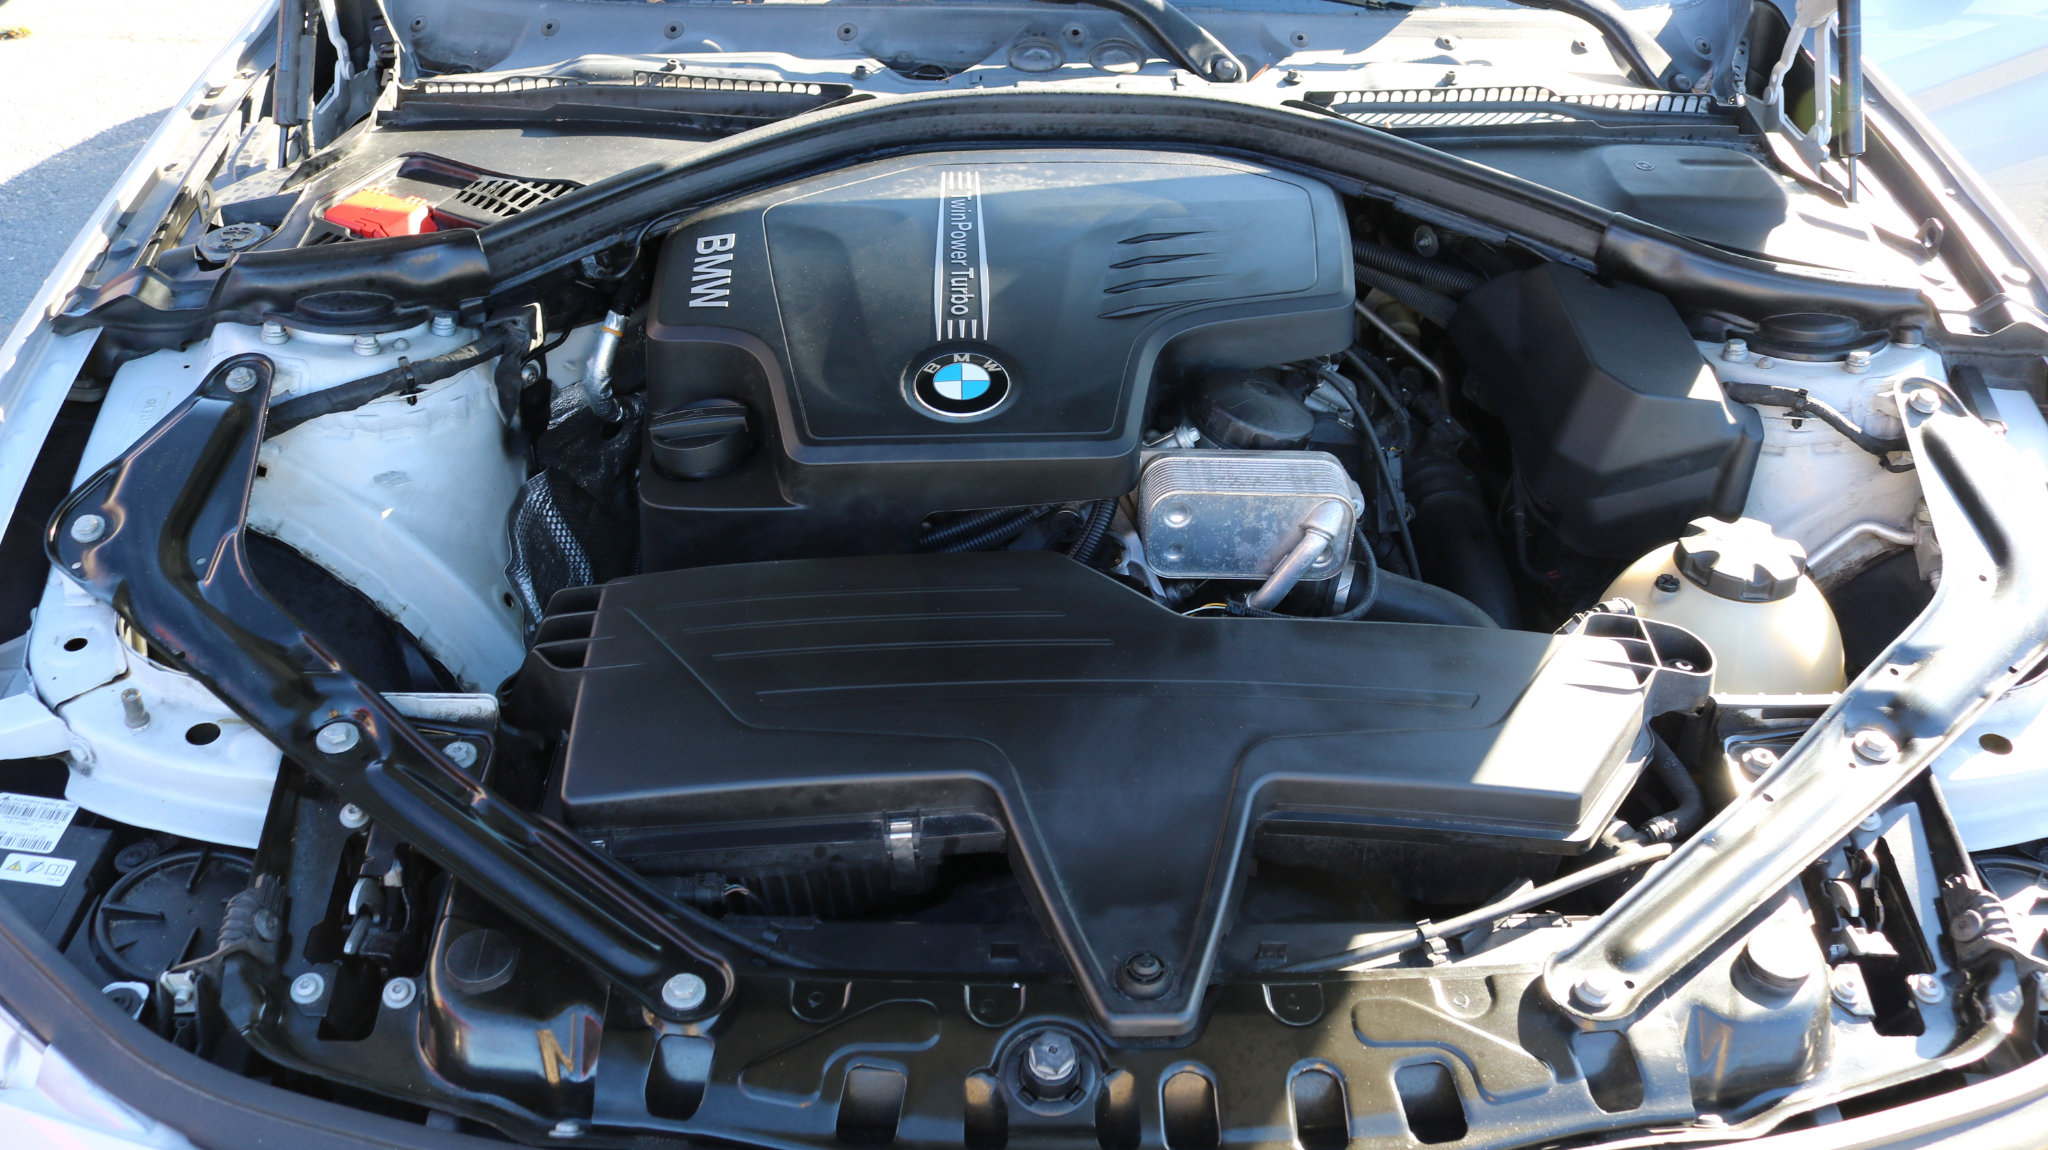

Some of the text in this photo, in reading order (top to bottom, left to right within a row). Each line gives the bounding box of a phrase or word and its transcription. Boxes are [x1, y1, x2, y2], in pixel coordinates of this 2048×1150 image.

[688, 233, 736, 308] BMW
[950, 190, 975, 316] TwinPower Turbo
[922, 353, 1002, 375] BMW
